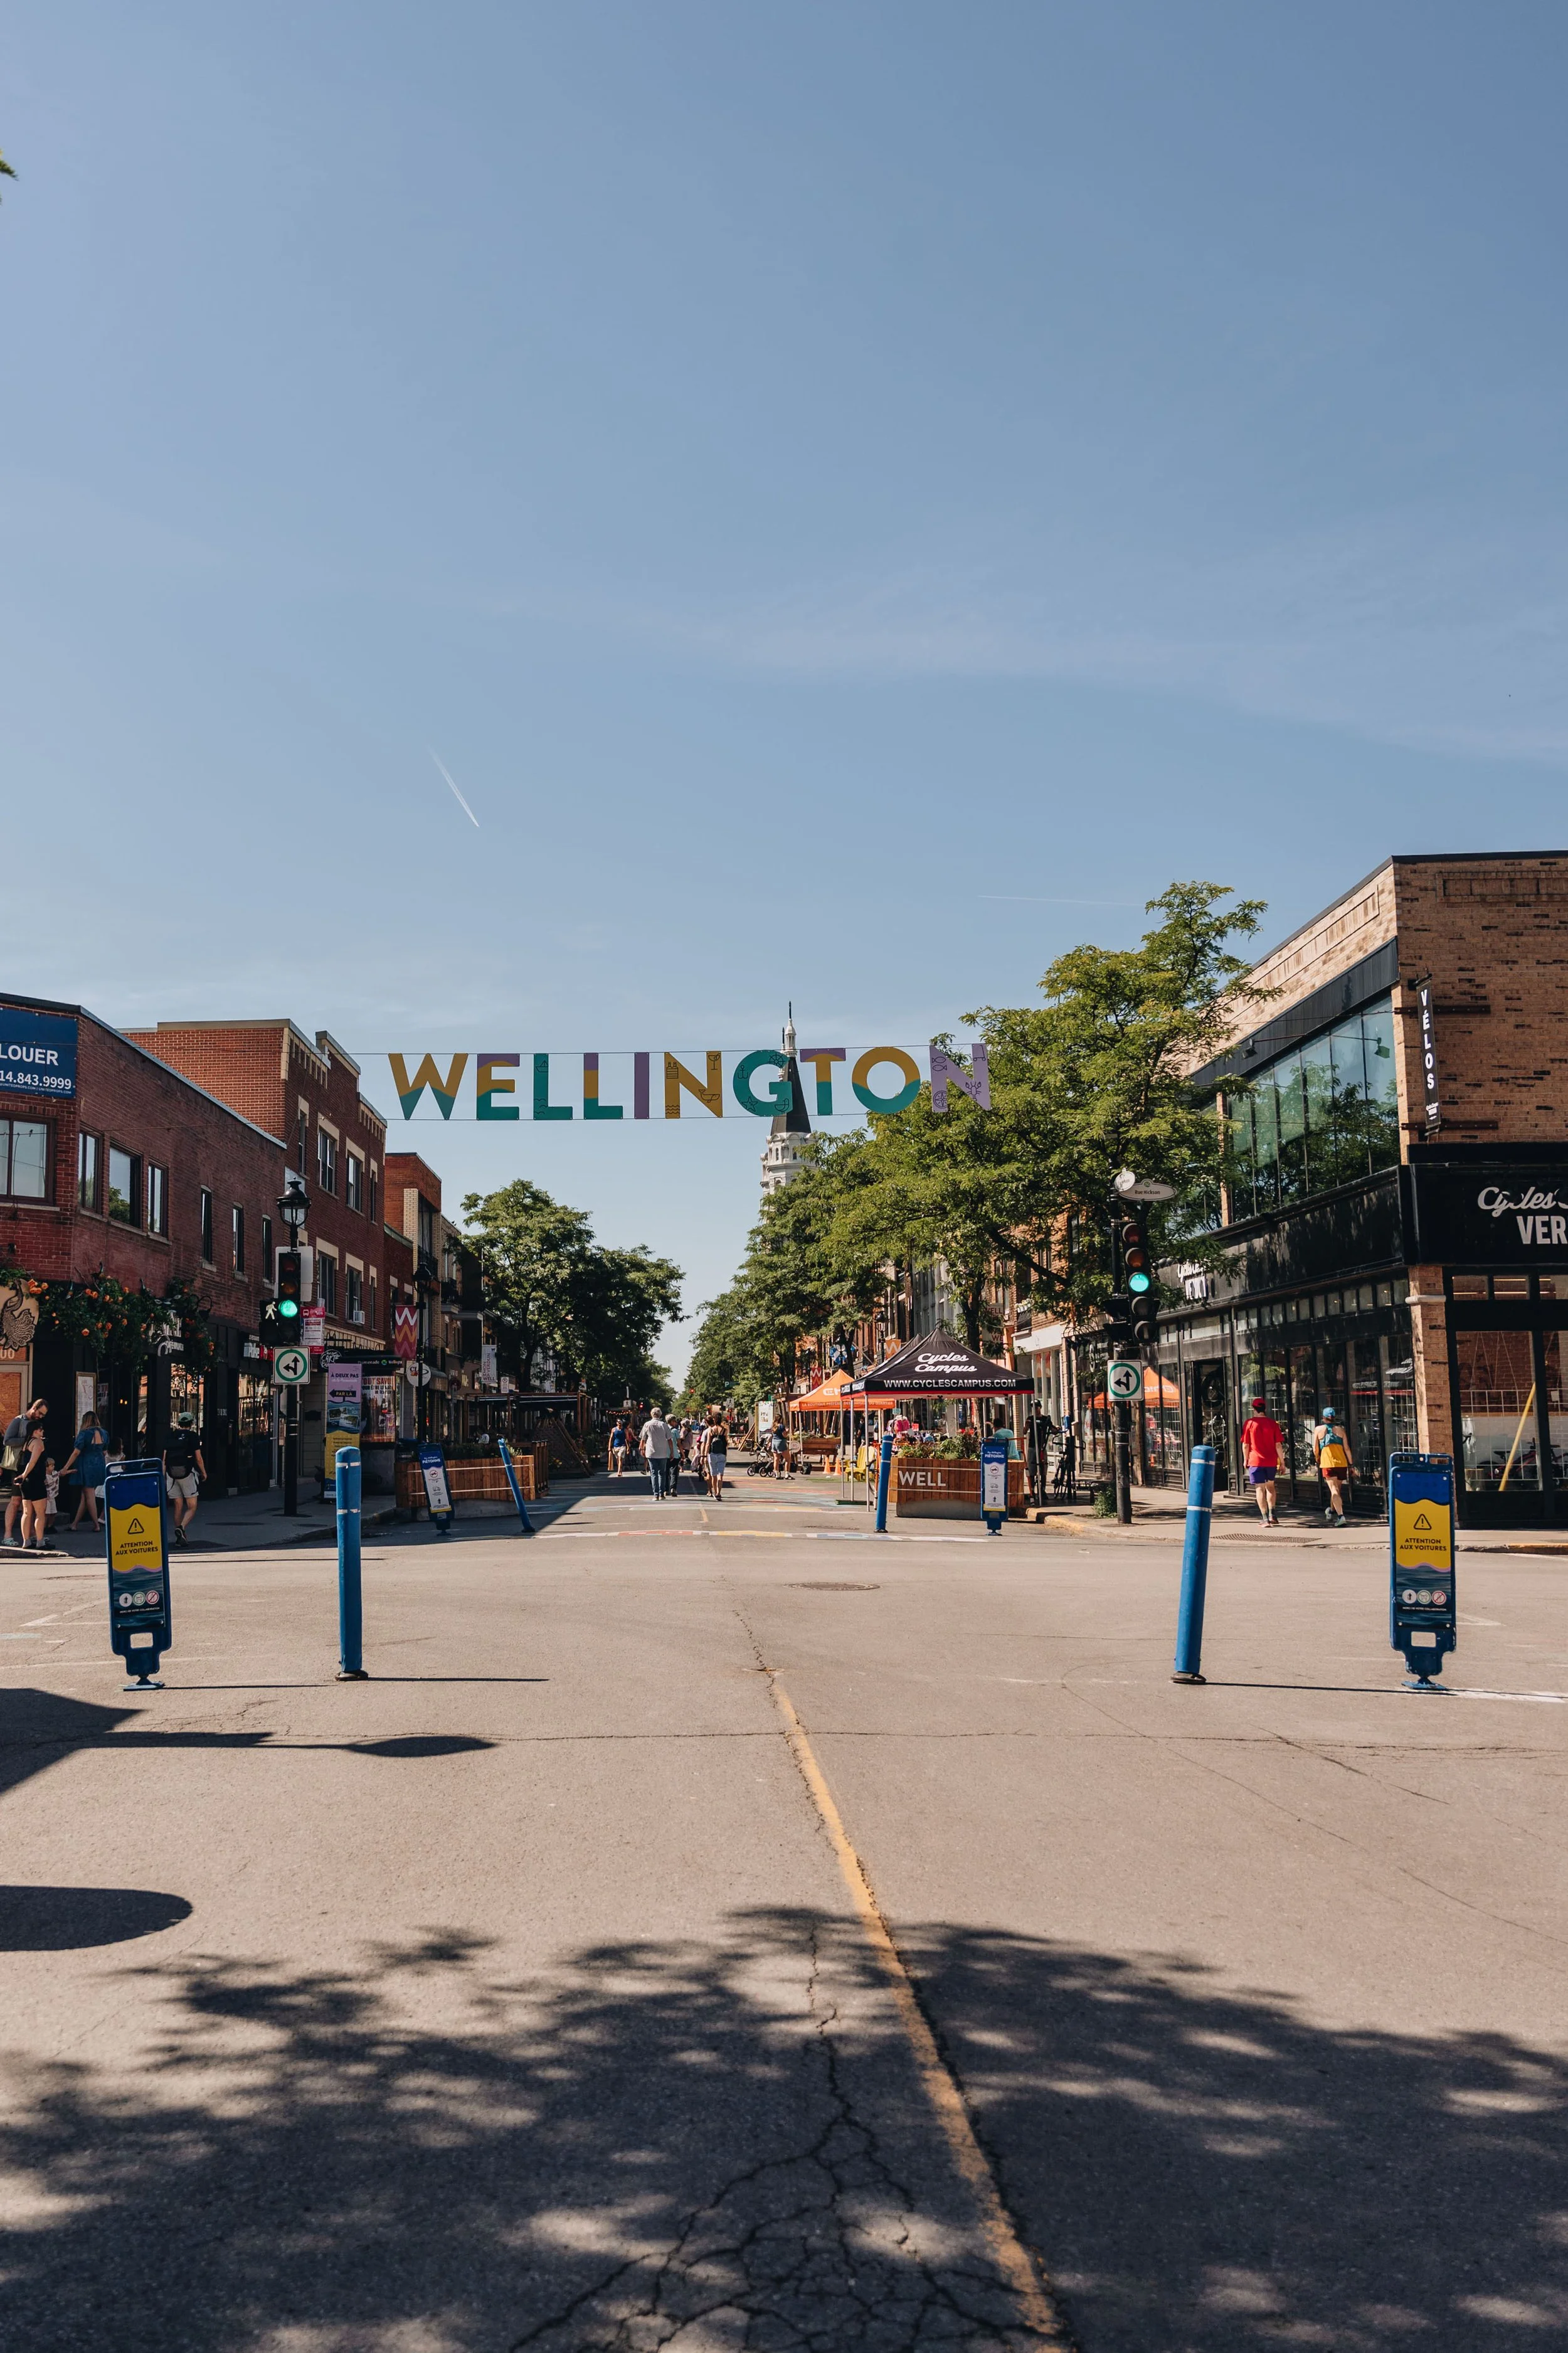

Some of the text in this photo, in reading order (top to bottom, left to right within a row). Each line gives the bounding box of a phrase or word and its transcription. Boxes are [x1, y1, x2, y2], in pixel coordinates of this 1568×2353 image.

[1419, 989, 1435, 1090] VÉLOS
[388, 1043, 991, 1120] WELLINGTON
[918, 1352, 970, 1364] Cycles
[914, 1364, 978, 1374] Campus
[884, 1379, 1016, 1388] WWW.CYCLESCAMPUS.COM
[899, 1470, 946, 1487] WELL
[120, 1540, 154, 1549] ATTENTION
[115, 1546, 159, 1556] AUX VOITURES
